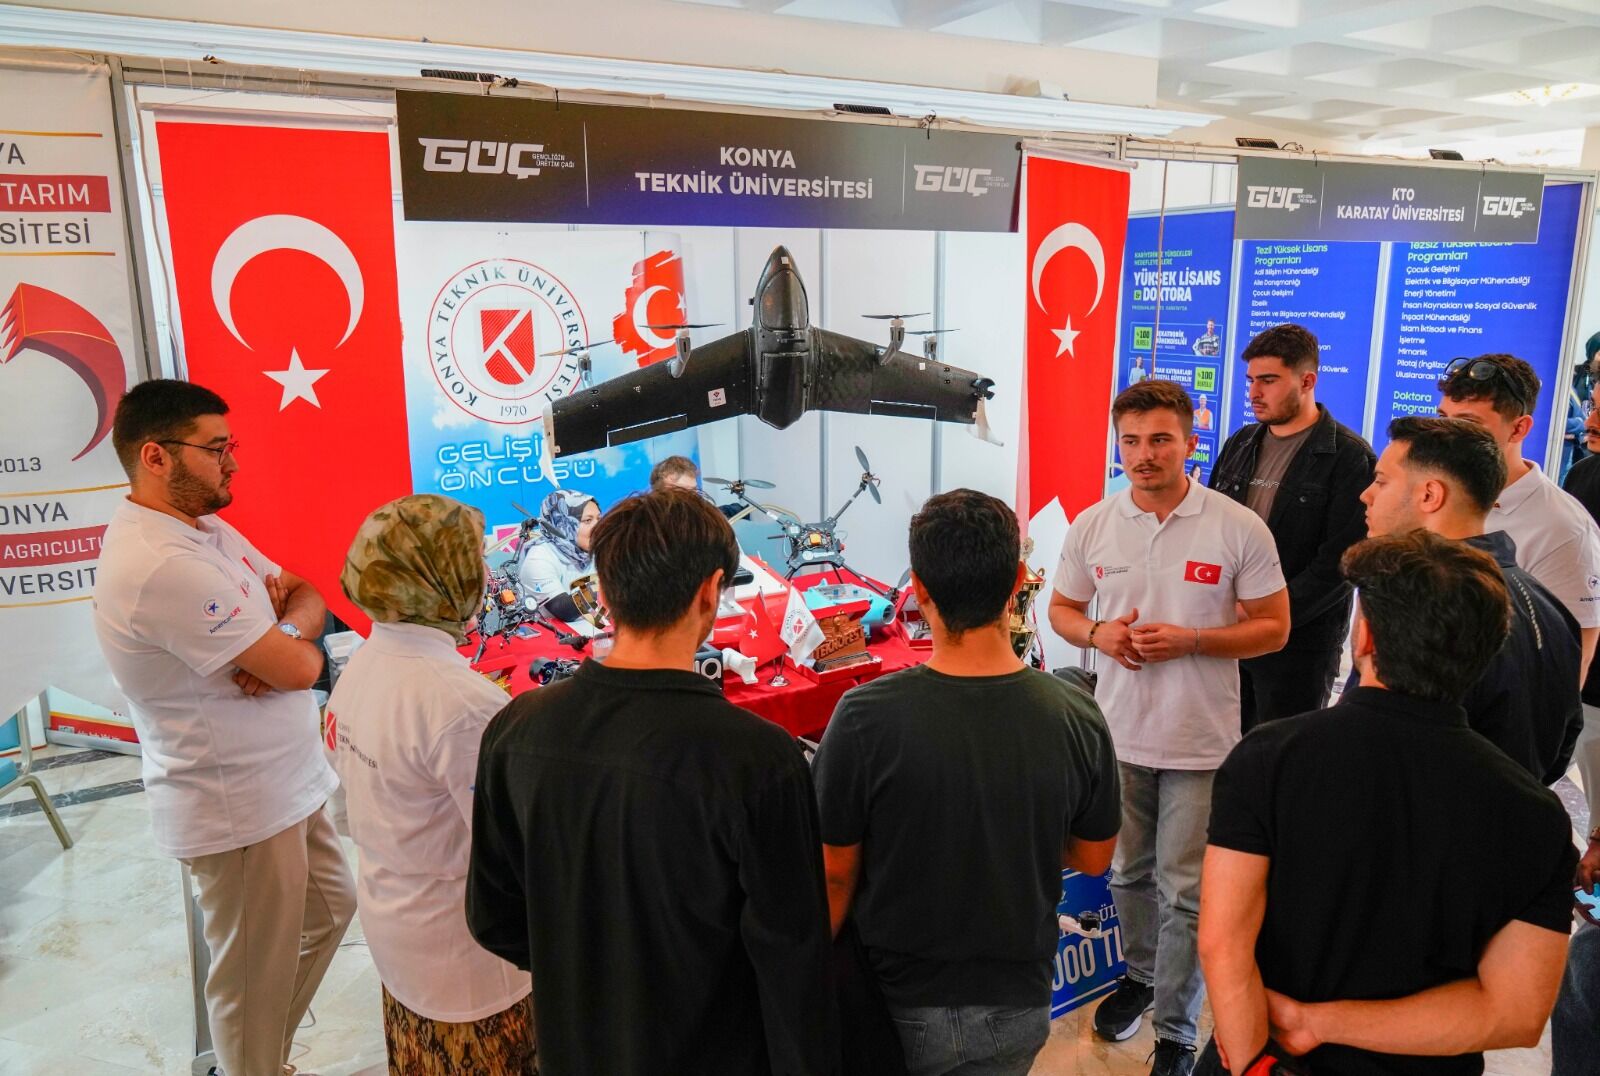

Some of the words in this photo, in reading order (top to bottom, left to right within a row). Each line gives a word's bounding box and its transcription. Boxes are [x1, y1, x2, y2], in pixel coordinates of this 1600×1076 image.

[0, 142, 25, 165] A
[720, 147, 796, 168] KONYA
[635, 170, 723, 194] TEKNİK
[729, 172, 872, 199] ÜNİVERSİTESİ
[0, 183, 90, 205] TARIM
[1392, 187, 1415, 202] KTO
[1336, 205, 1391, 221] KARATAY
[1391, 205, 1465, 222] ÜNİVERSİTESİ
[0, 218, 91, 244] SİTESİ
[1274, 245, 1301, 255] Yüksek
[1302, 244, 1328, 253] Lisans
[1255, 256, 1302, 267] Programları
[1408, 251, 1468, 264] Programları
[1134, 268, 1177, 286] YÜKSEK
[1179, 267, 1221, 286] LİSANS
[1406, 266, 1430, 275] Çocuk
[1431, 265, 1460, 275] Gelişimi
[1405, 278, 1431, 286] Elektrik
[1442, 277, 1479, 287] Bilgisayar
[1480, 276, 1531, 287] Mühendisliği
[437, 266, 506, 323] TEKNİK
[1143, 287, 1192, 301] DOKTORA
[1404, 290, 1424, 299] Enerji
[1425, 290, 1456, 298] Yönetimi
[1403, 301, 1421, 309] İnsan
[1423, 302, 1463, 311] Kaynakları
[1475, 302, 1501, 311] Sosyal
[1502, 302, 1537, 310] Güvenlik
[1402, 312, 1424, 322] İnşaat
[1425, 313, 1471, 323] Mühendisliği
[1401, 324, 1420, 333] İslam
[1400, 335, 1425, 345] İşletme
[435, 336, 479, 407] KONYA
[1395, 371, 1436, 380] Uluslararası
[1393, 390, 1432, 402] Doktora
[500, 405, 527, 416] 1970
[1392, 402, 1437, 415] Programl
[439, 435, 541, 463] GELİŞİ
[440, 459, 596, 491] ÖNCÜSÜ
